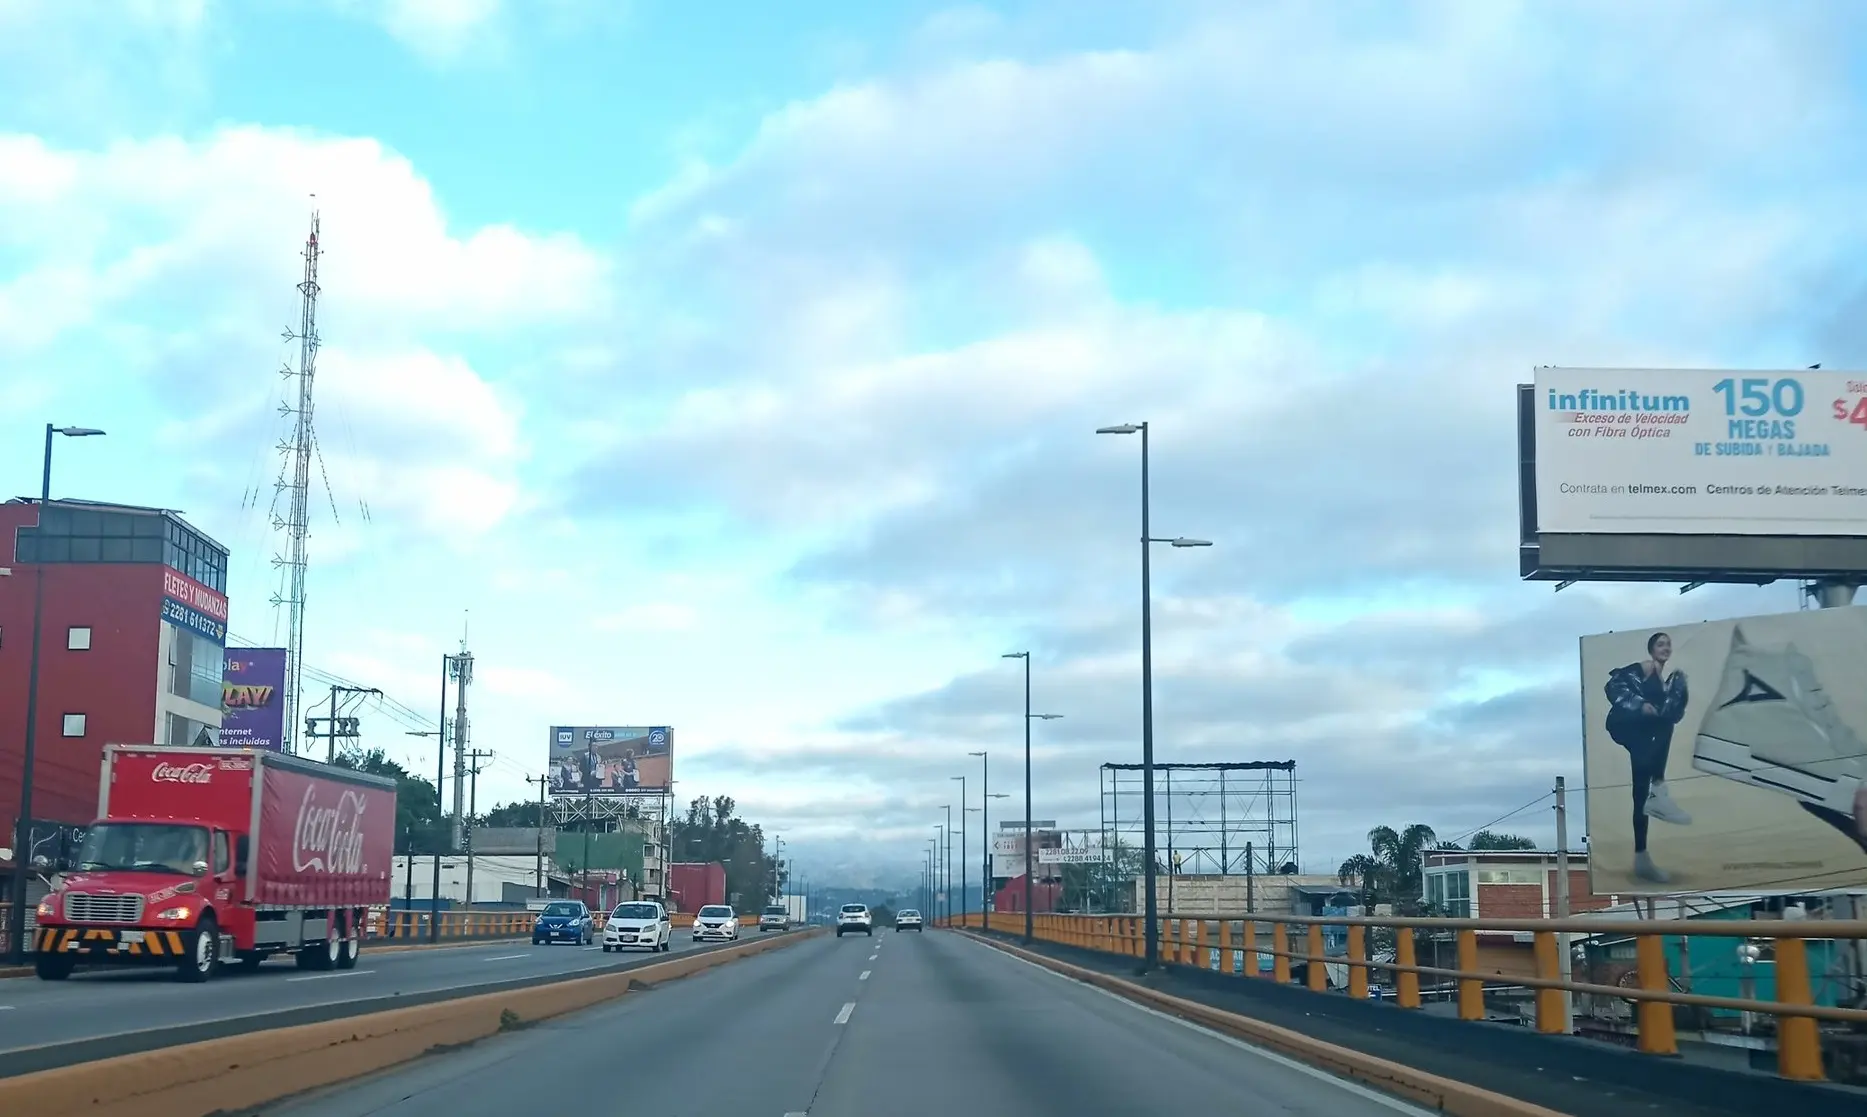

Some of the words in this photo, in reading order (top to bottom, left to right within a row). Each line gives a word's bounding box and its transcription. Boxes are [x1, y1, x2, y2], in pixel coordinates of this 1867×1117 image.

[1548, 388, 1690, 412] infinitum
[1712, 378, 1804, 418] 150
[1574, 412, 1615, 425] Exceso
[1617, 412, 1632, 425] de
[1635, 412, 1690, 425] Velocidad
[1568, 427, 1591, 438] con
[1594, 426, 1627, 438] Fibra
[1630, 425, 1671, 440] Óptica
[1728, 419, 1796, 440] MEGAS
[1694, 442, 1713, 456] DE
[1715, 443, 1763, 457] SUBIDA
[1777, 444, 1831, 458] BAJADA
[1560, 482, 1608, 494] Contrata
[1611, 485, 1625, 494] en
[1628, 483, 1697, 495] telmex.com
[1706, 484, 1754, 496] Centros
[1757, 484, 1772, 496] de
[1775, 484, 1828, 497] Atención
[164, 572, 189, 601] FLETES
[189, 585, 195, 603] Y
[195, 588, 227, 619] MUDANZAS
[169, 603, 189, 624] 2281
[189, 611, 216, 637] 611372
[222, 685, 274, 706] LAY!
